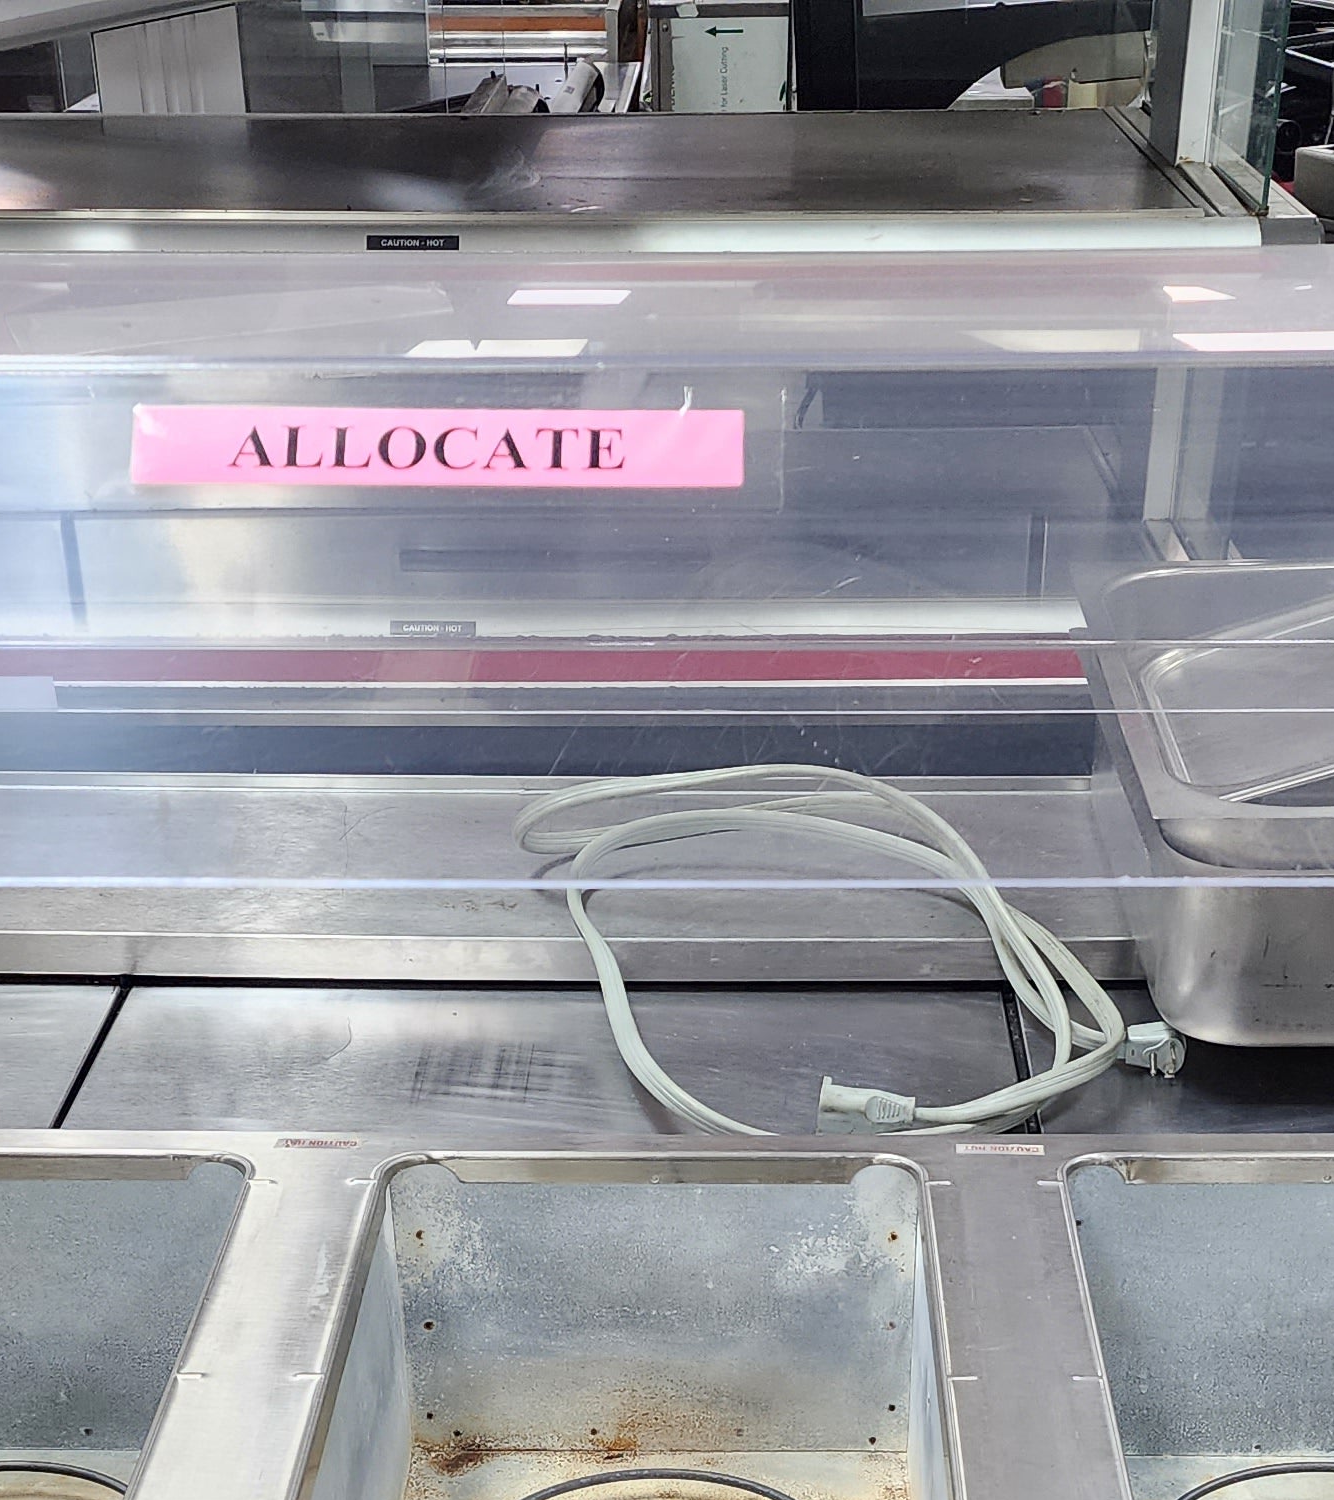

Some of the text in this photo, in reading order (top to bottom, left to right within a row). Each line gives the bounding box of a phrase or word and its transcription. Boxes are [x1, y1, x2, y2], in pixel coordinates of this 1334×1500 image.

[380, 239, 419, 247] CAUTION
[426, 239, 445, 247] HOT
[229, 425, 626, 470] ALLOCATE
[403, 624, 439, 632] CAUTION
[445, 624, 461, 632] HOT
[991, 1145, 1040, 1153] CAUTION
